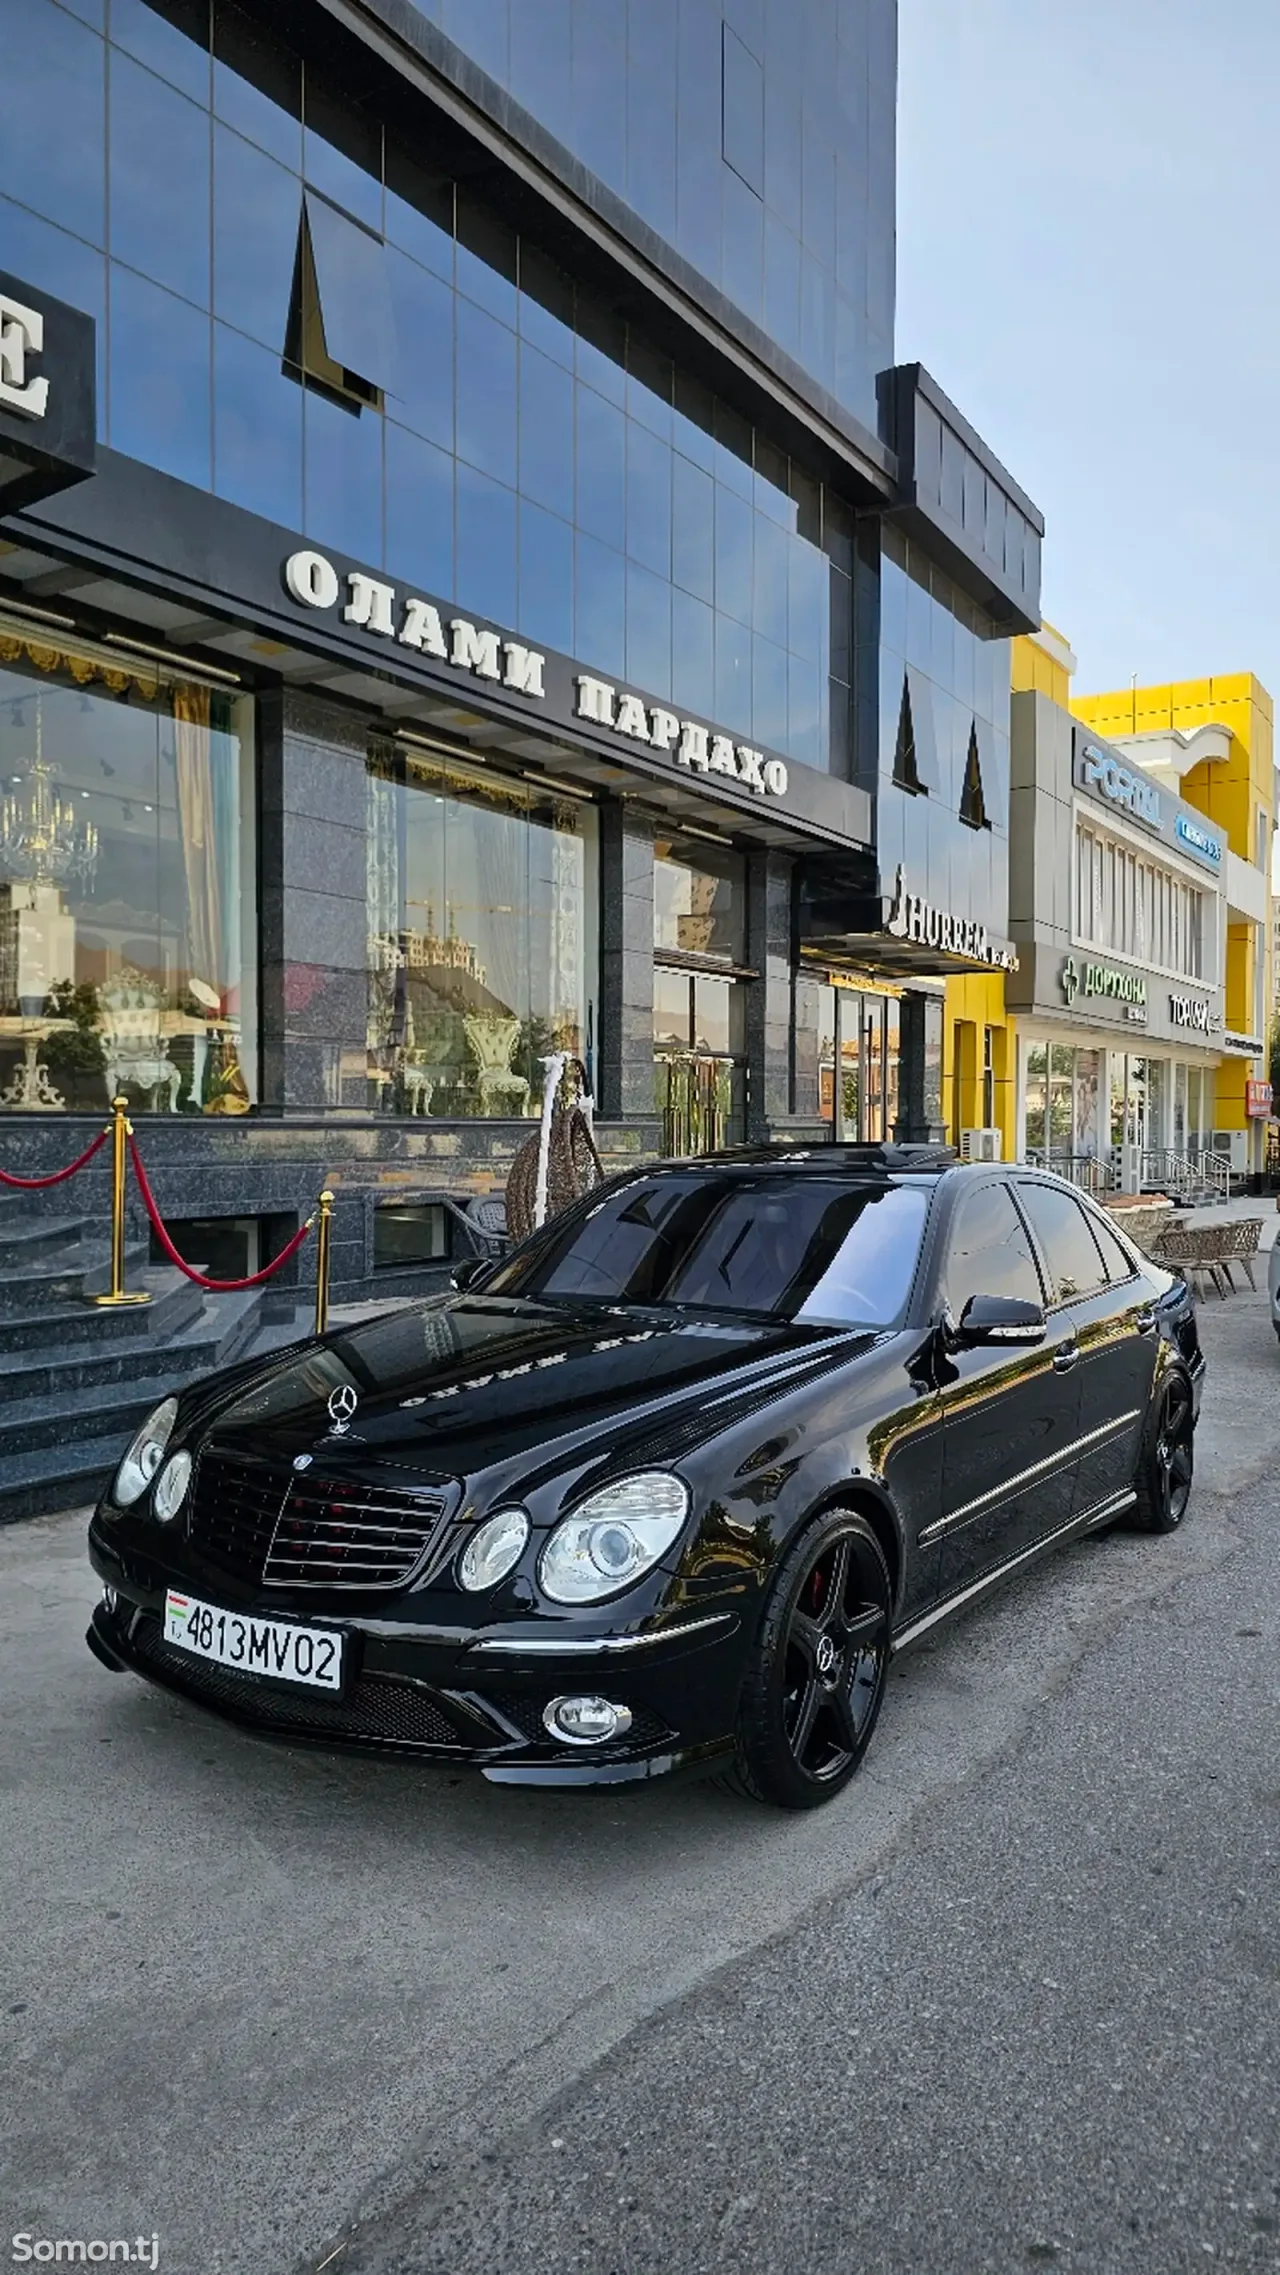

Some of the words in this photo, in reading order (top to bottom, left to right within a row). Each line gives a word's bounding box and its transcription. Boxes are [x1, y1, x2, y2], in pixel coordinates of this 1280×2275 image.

[285, 550, 545, 699] ОЛАМИ
[1084, 962, 1147, 1006] ДОРУХОНА
[187, 1605, 335, 1682] 4813MV02
